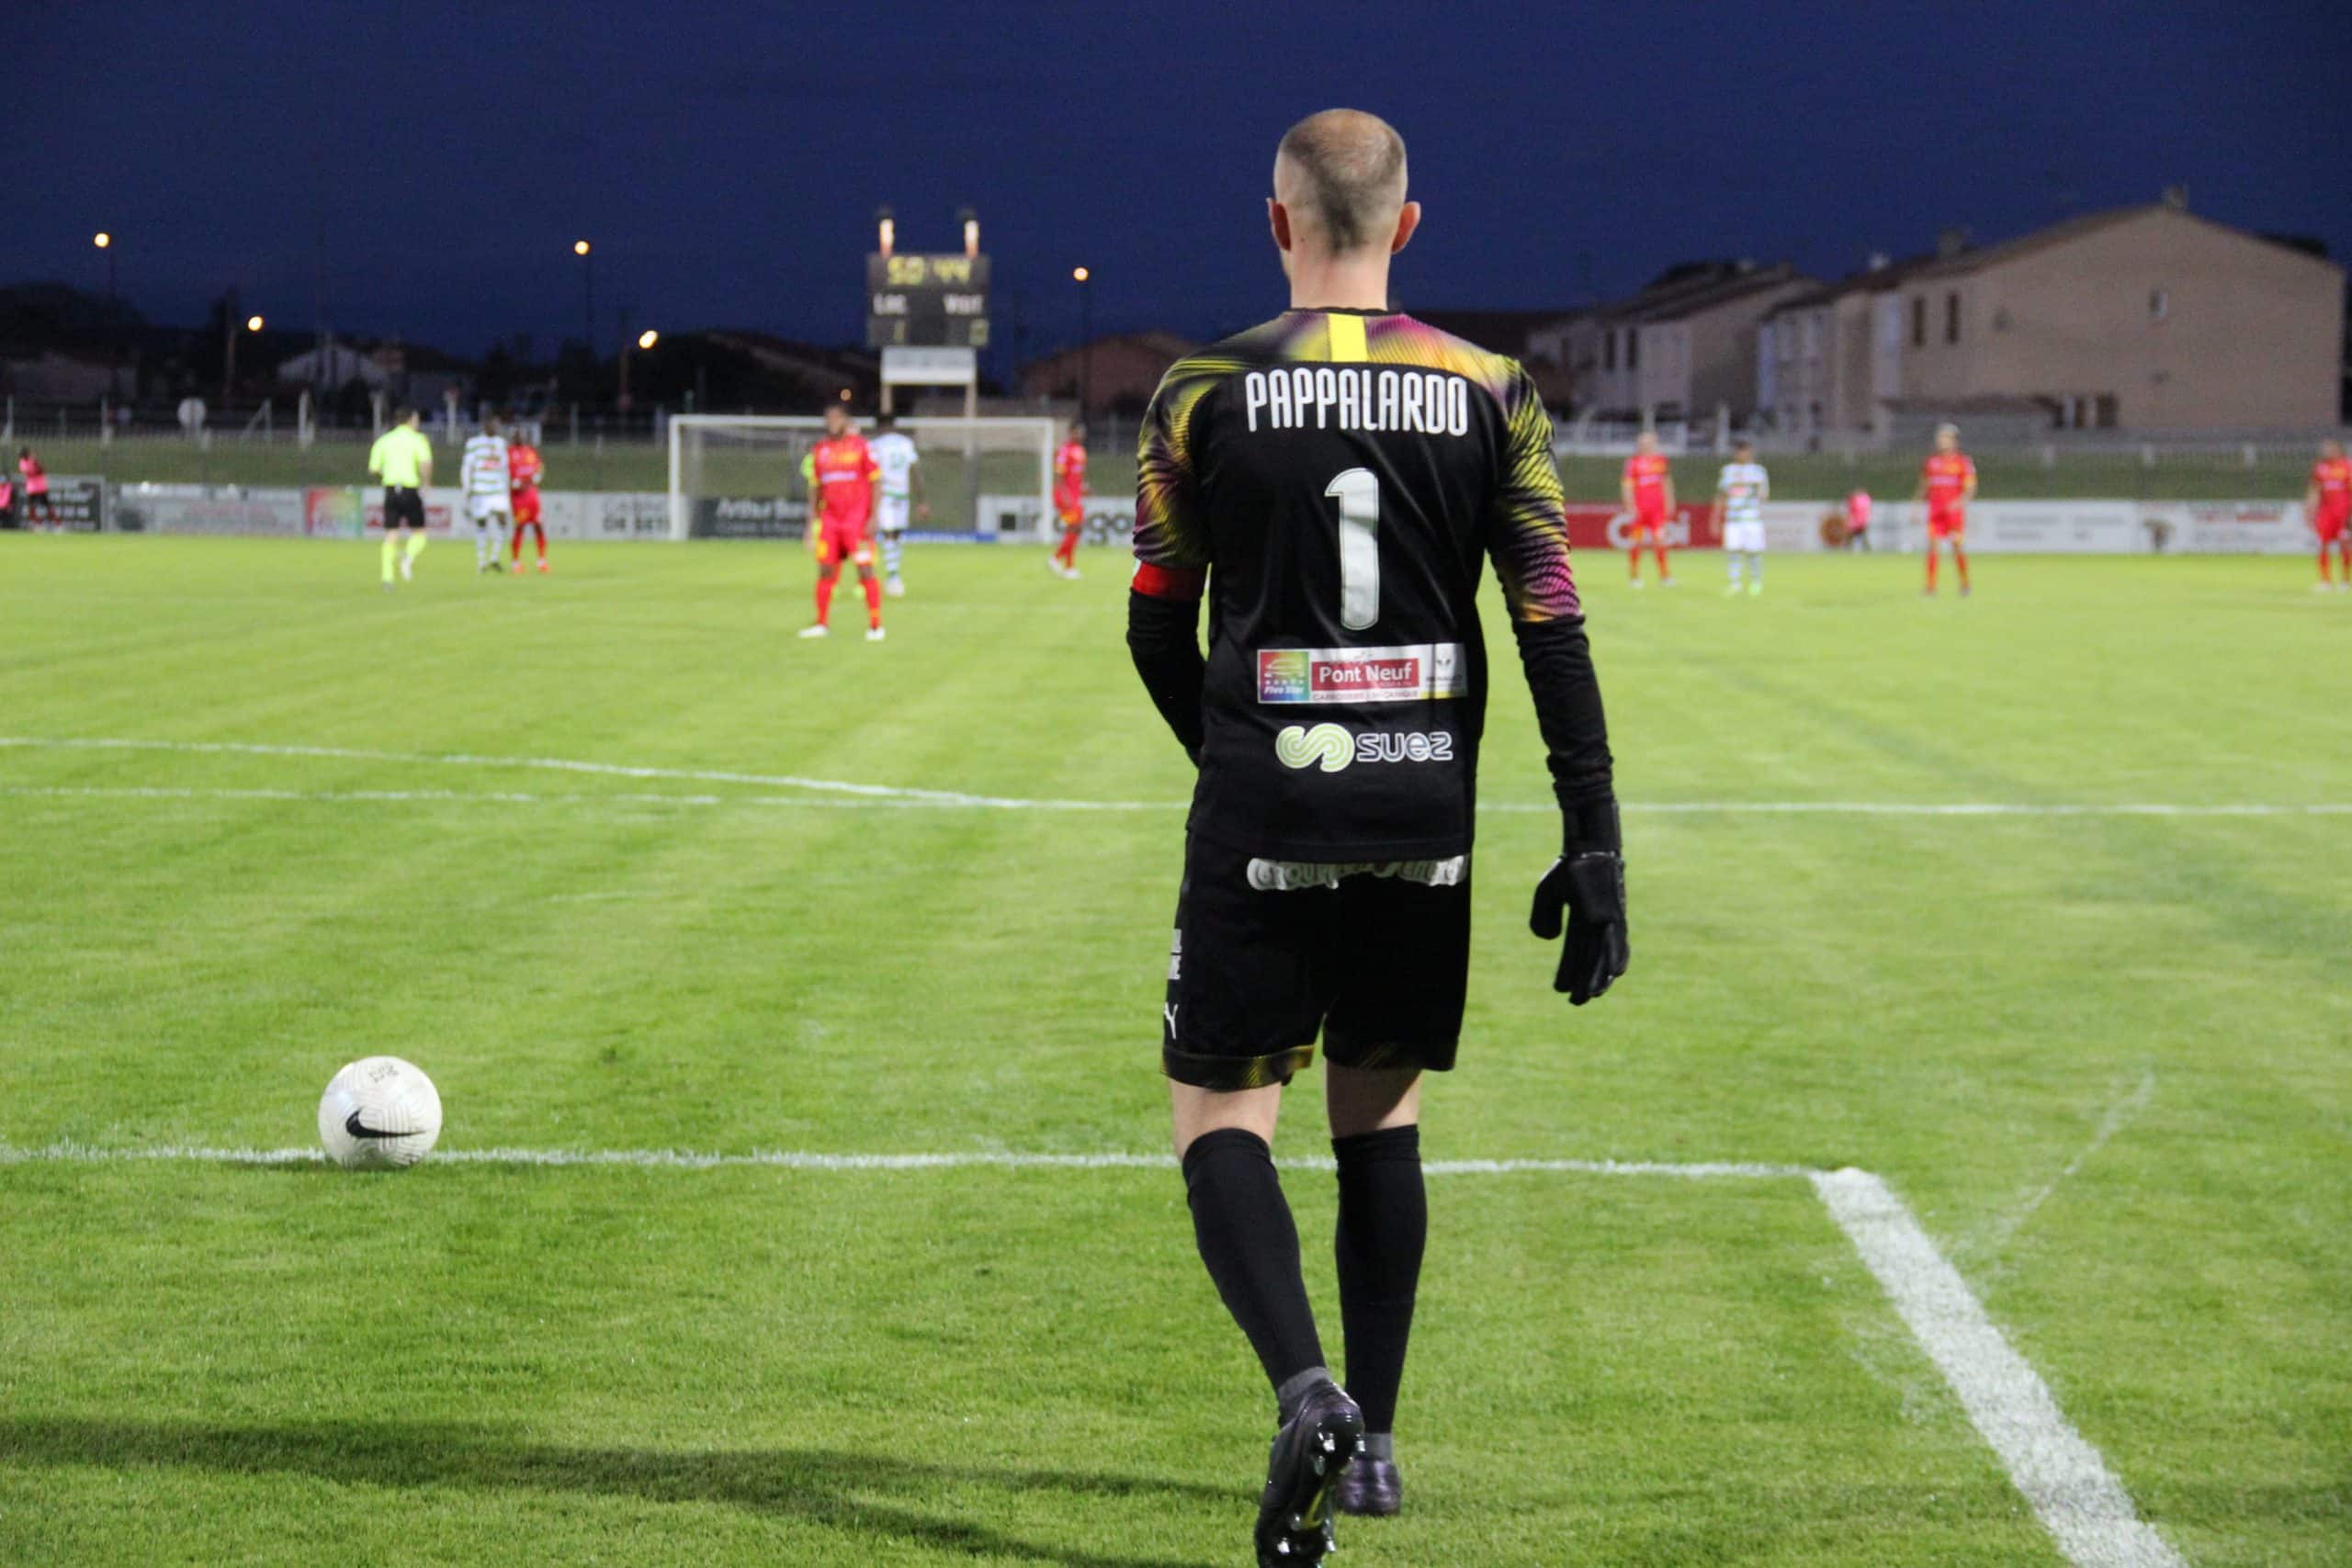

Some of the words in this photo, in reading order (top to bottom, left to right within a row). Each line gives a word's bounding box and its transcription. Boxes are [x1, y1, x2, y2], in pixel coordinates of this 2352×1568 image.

[1245, 367, 1468, 437] PAPPALARDO
[1324, 468, 1380, 631] 1
[1319, 666, 1362, 683] Pont
[1366, 662, 1412, 682] Neuf
[1356, 731, 1454, 762] suez
